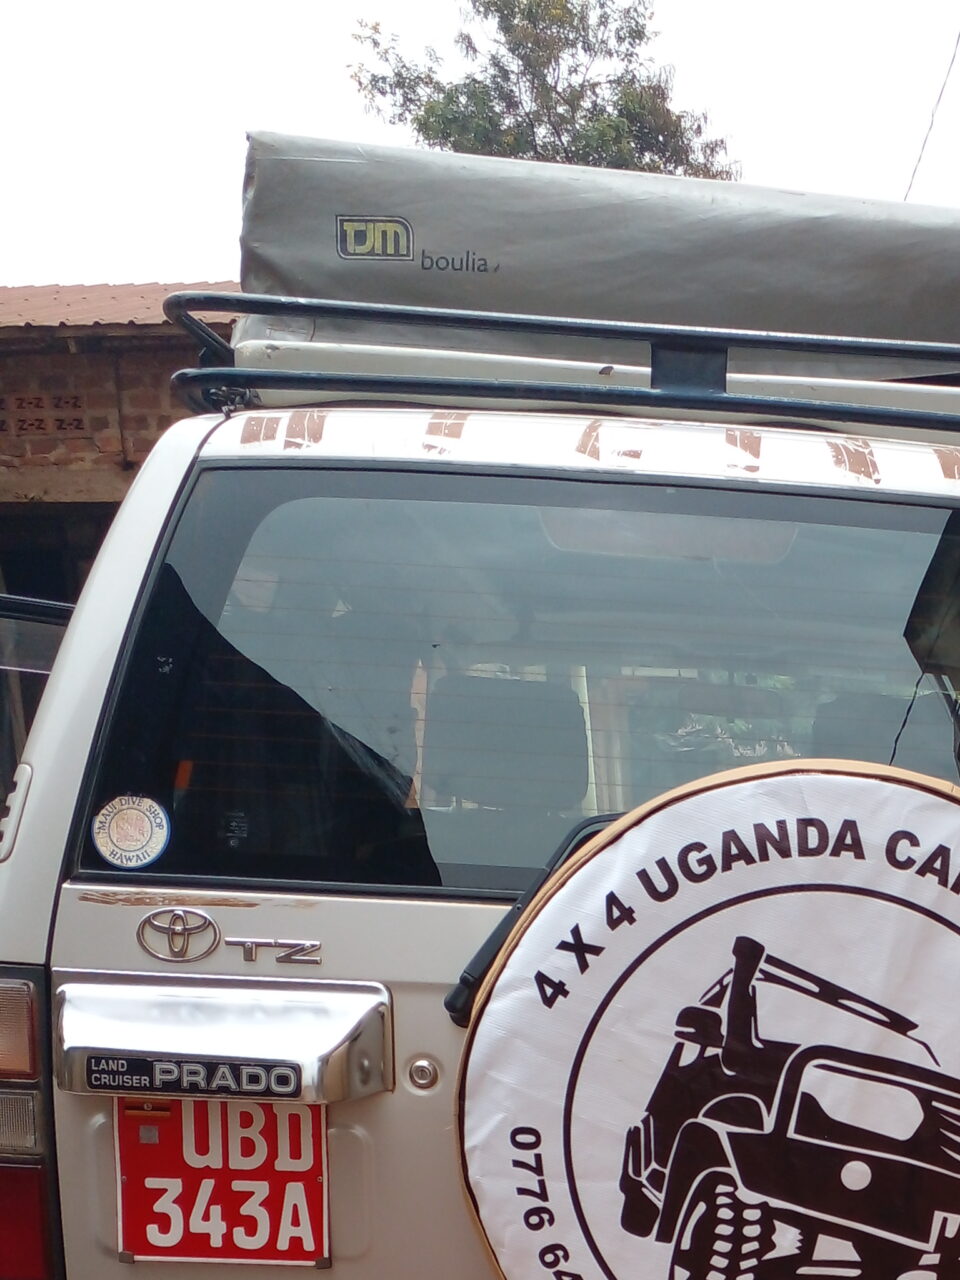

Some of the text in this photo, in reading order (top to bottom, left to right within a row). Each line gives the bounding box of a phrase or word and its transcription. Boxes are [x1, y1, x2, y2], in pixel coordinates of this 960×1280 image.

[342, 221, 408, 255] TJM
[420, 249, 489, 273] boulia
[96, 796, 165, 834] MAUI DIVE SHOP
[108, 848, 151, 865] HAWAII
[534, 970, 569, 1010] 4
[556, 923, 605, 975] X
[606, 890, 636, 932] 4
[635, 817, 866, 903] UGANDA
[224, 937, 322, 965] TZ
[91, 1058, 128, 1072] LAND
[91, 1073, 150, 1088] CRUISER
[152, 1061, 299, 1095] PRADO
[181, 1100, 314, 1172] UBD
[509, 1126, 556, 1232] 0776
[144, 1177, 316, 1252] 343A
